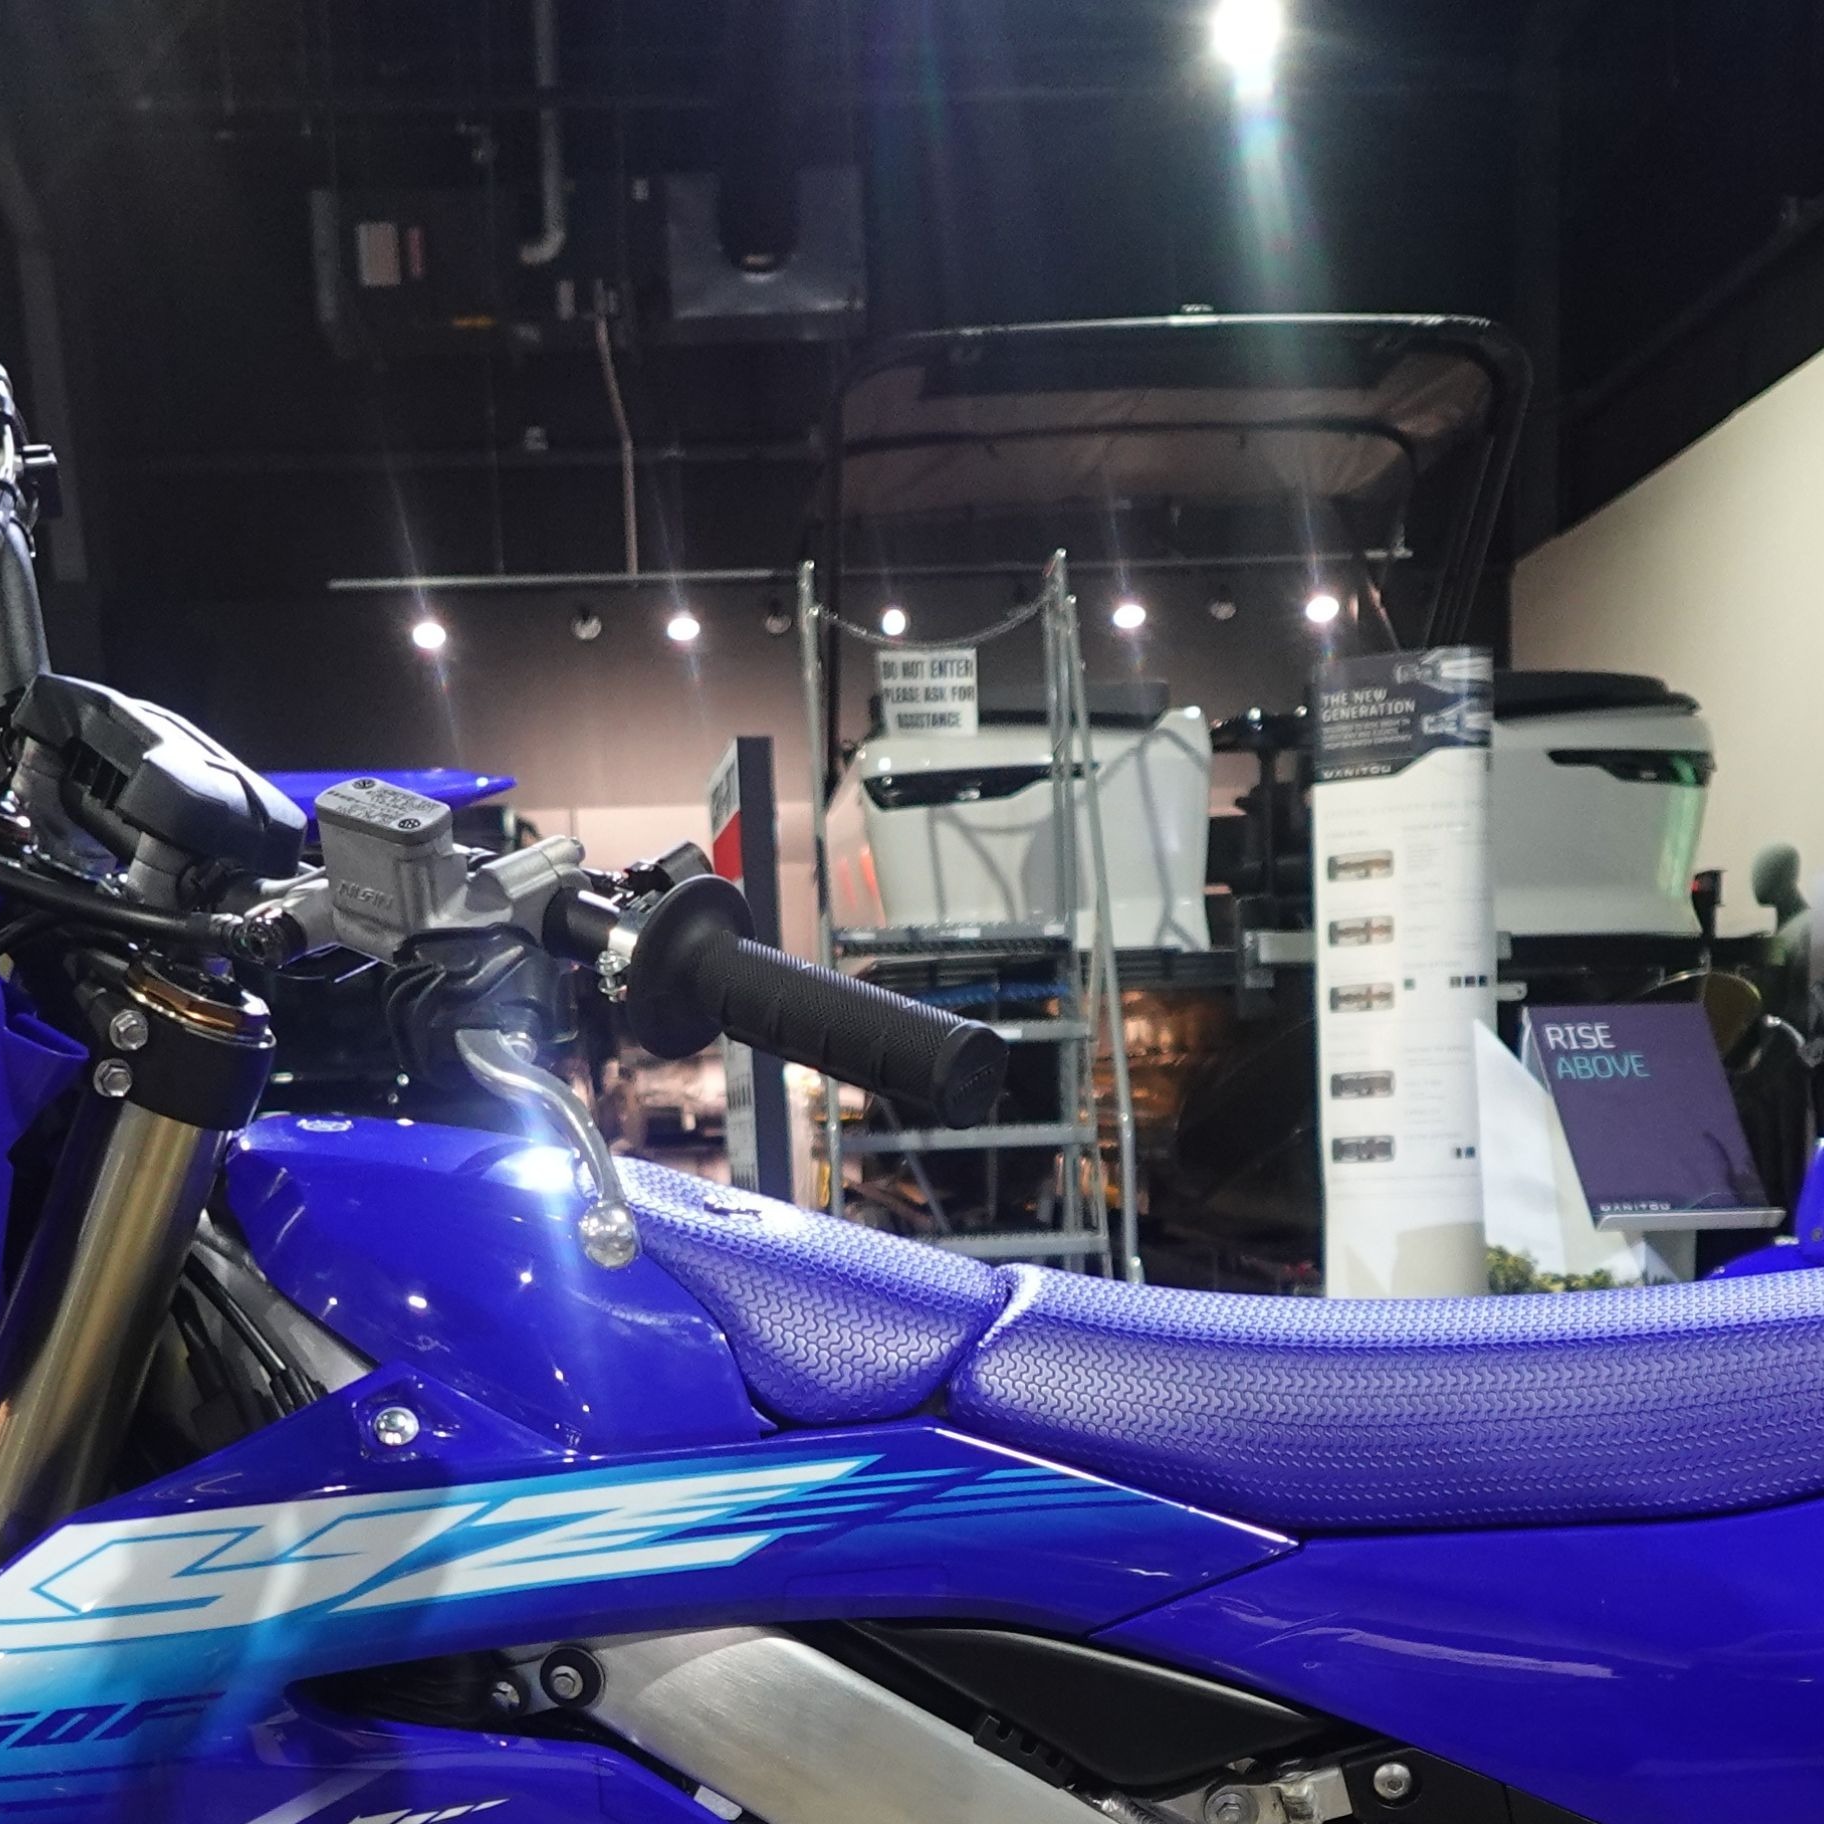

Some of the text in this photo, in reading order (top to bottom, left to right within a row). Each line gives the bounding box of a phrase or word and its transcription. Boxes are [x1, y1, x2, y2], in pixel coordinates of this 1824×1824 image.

[930, 658, 974, 679] ENTER
[1323, 687, 1388, 710] THE NEW
[1322, 699, 1417, 723] GENERATION
[1545, 1022, 1617, 1051] RISE
[1556, 1053, 1651, 1080] ABOVE
